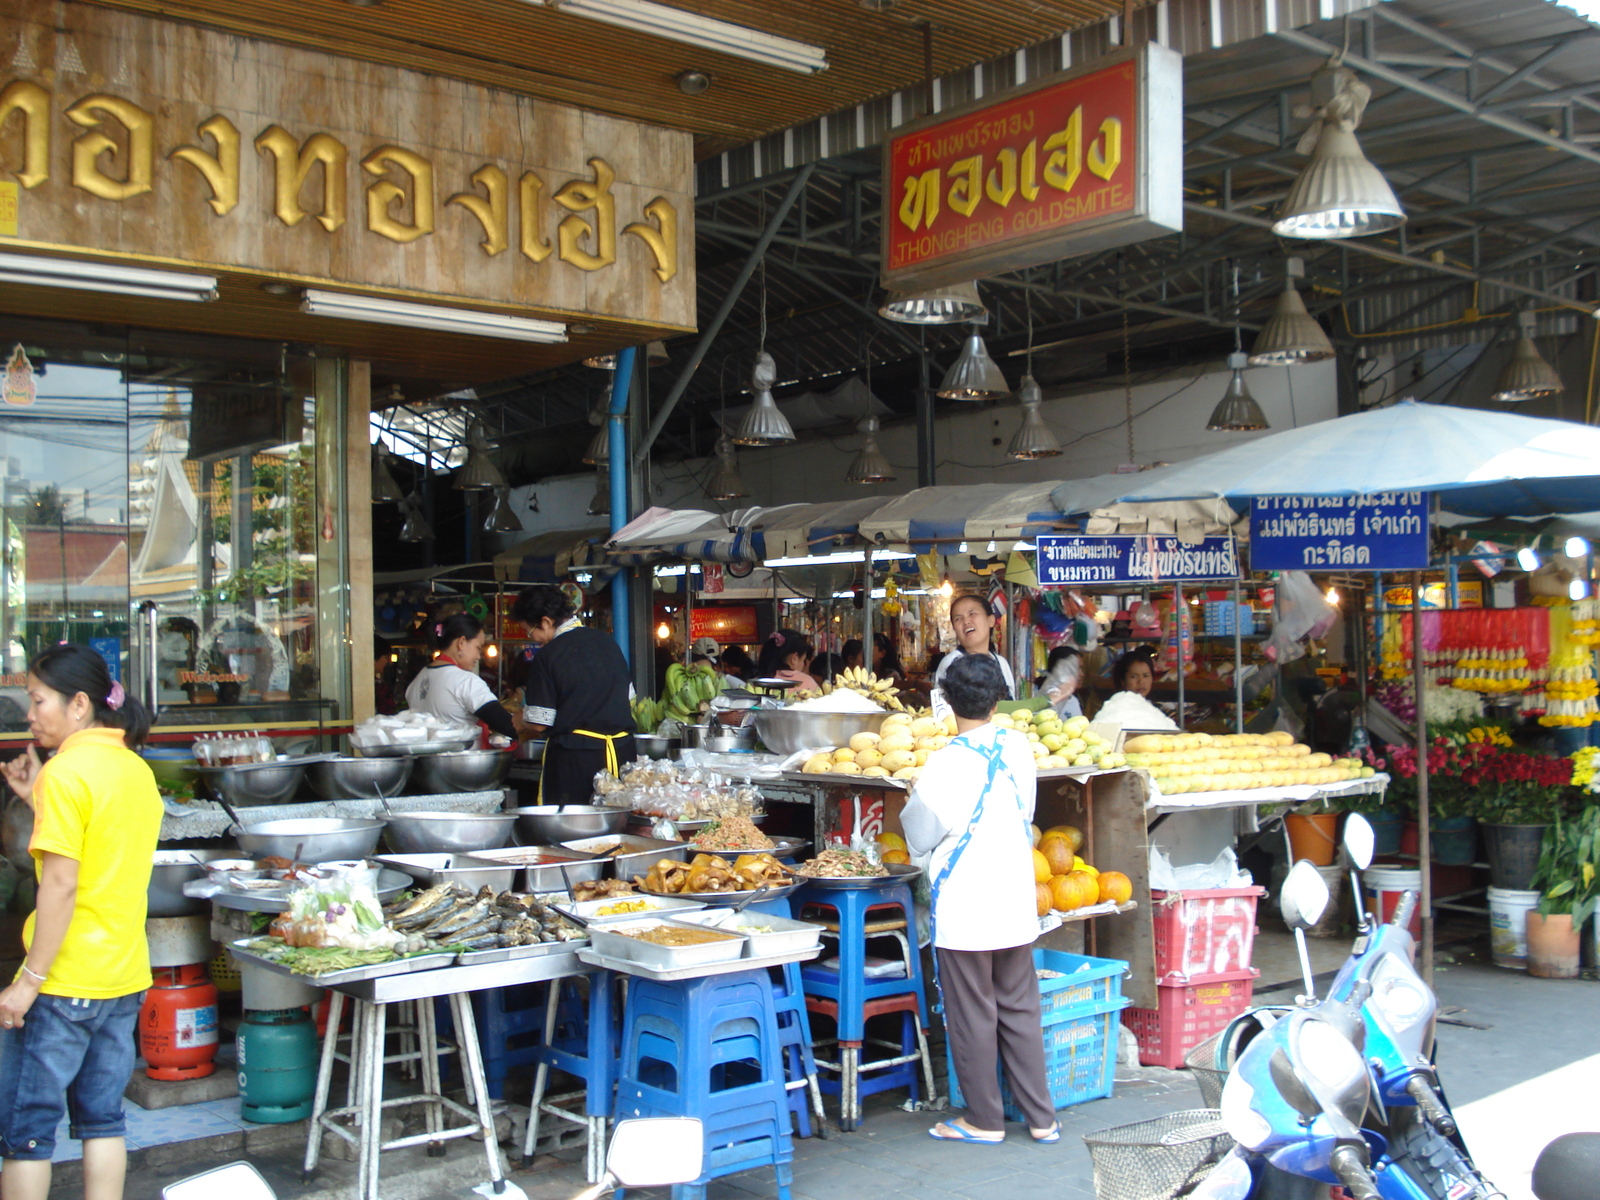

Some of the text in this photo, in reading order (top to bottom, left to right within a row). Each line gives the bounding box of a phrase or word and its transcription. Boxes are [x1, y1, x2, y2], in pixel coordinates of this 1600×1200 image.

[908, 110, 1034, 167] ห้างเพชรทอง
[898, 103, 1122, 232] ทองเฮง
[897, 184, 1124, 263] THONGHENG GOLDSMITE
[1259, 508, 1421, 537] แม่พัชรินทร์ เจ้าเก่า
[1303, 539, 1371, 565] กะทิสด
[1048, 565, 1116, 581] ขนมหวาน
[180, 670, 250, 683] Welcome
